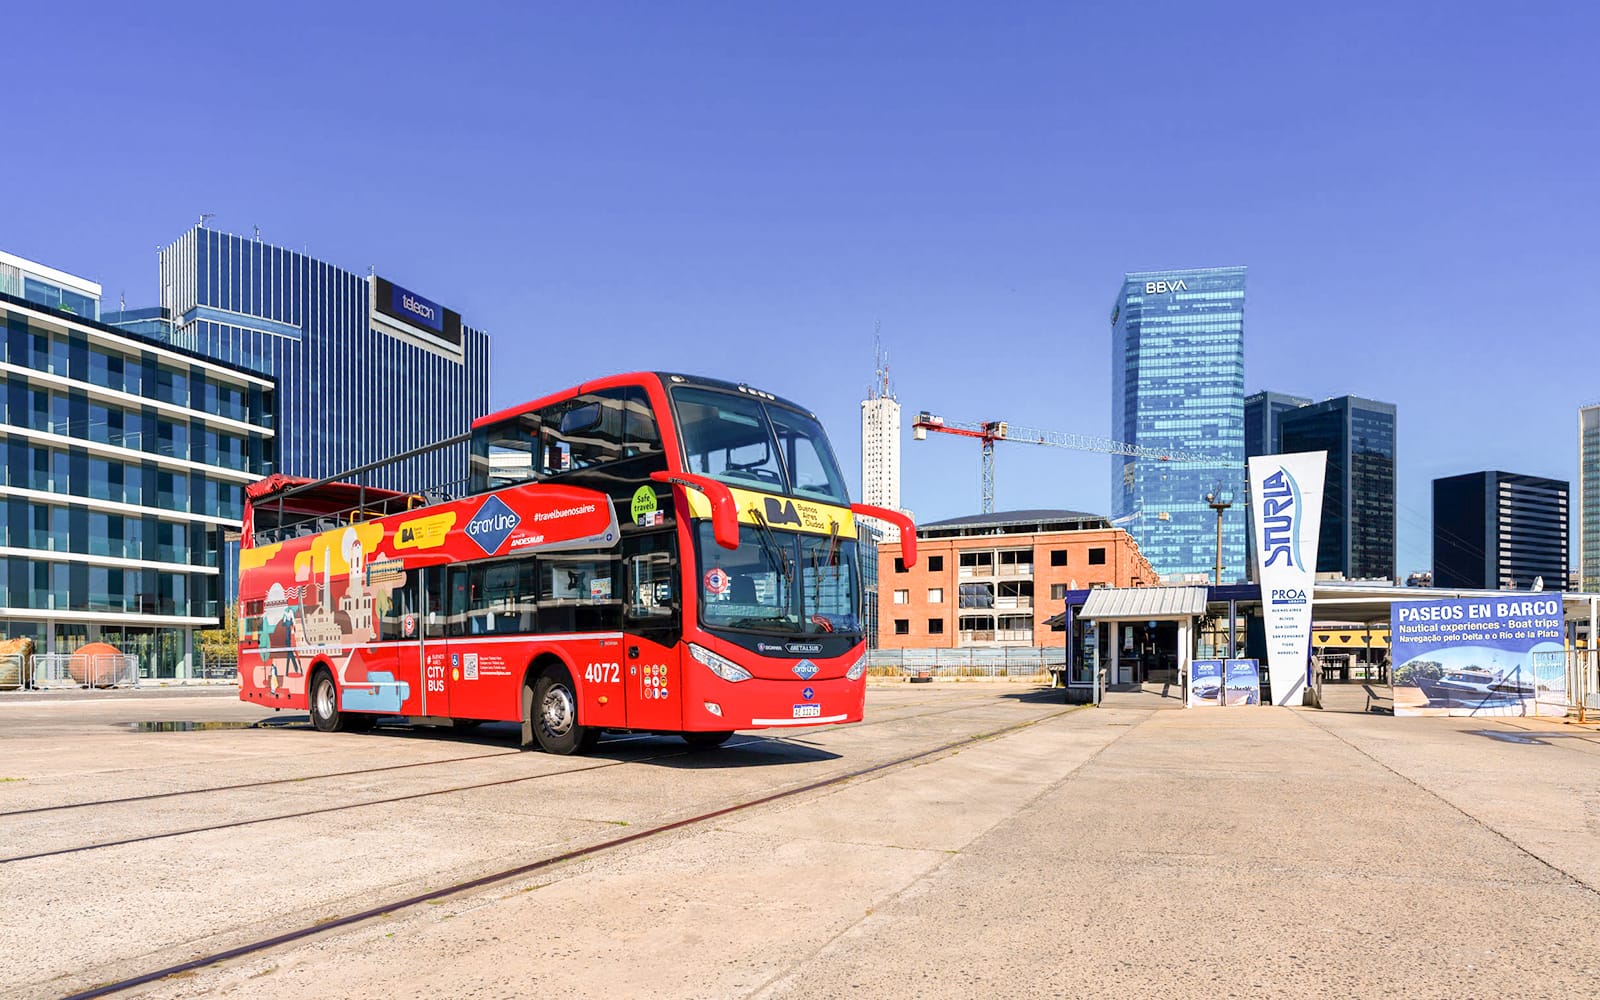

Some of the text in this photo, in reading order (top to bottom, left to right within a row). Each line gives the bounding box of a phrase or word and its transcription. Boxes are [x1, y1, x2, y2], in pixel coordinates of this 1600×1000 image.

[1146, 280, 1187, 294] BBVA
[637, 494, 651, 503] Safe
[534, 504, 596, 522] #travelbuenosaires
[634, 502, 655, 512] travels
[764, 497, 802, 527] BA
[797, 503, 818, 514] Buenos
[802, 511, 818, 521] Aires
[1263, 470, 1294, 568] STURLA
[805, 520, 825, 529] Ciudad
[511, 535, 545, 547] ANDESMAR
[1272, 589, 1307, 599] PROA
[1399, 600, 1558, 622] PASEOS EN BARCO
[1399, 618, 1559, 633] Nautical experiences Boat trips
[1400, 634, 1442, 644] Navegação
[1443, 634, 1460, 642] pelo
[1537, 630, 1559, 638] Plata
[427, 666, 445, 679] CITY
[585, 663, 620, 683] 4072
[428, 680, 445, 692] BUS
